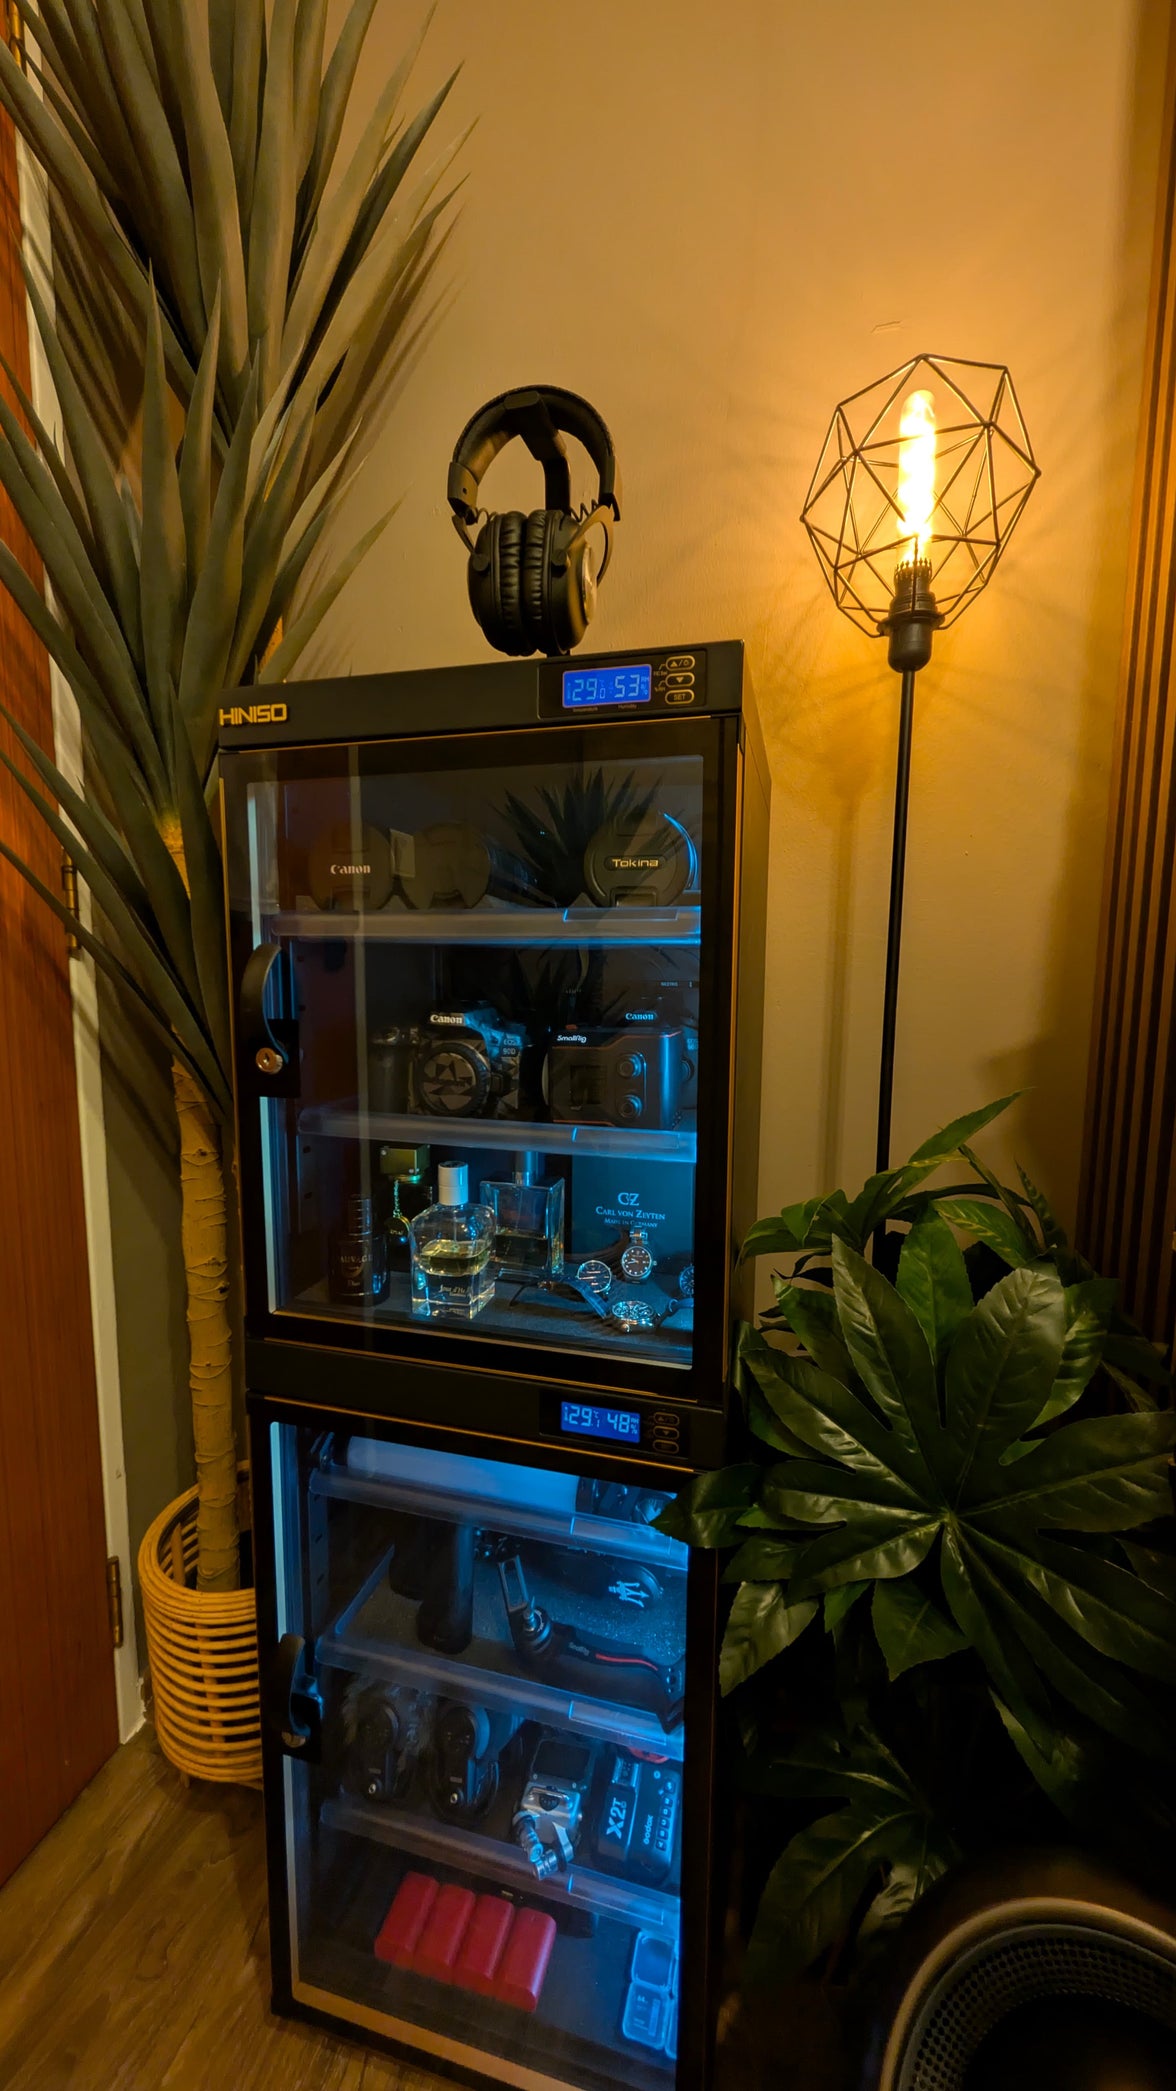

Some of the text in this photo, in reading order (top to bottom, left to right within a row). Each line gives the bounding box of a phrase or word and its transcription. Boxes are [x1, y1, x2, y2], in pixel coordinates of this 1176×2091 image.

[572, 678, 597, 701] 29
[614, 674, 640, 698] 53
[219, 703, 287, 726] HINISO
[330, 864, 371, 874] Canon
[612, 858, 659, 868] Tokina
[430, 1014, 463, 1024] Canon
[625, 1012, 654, 1020] Canon
[569, 1405, 593, 1427] 29
[607, 1413, 631, 1434] 48
[606, 1797, 627, 1839] X2T
